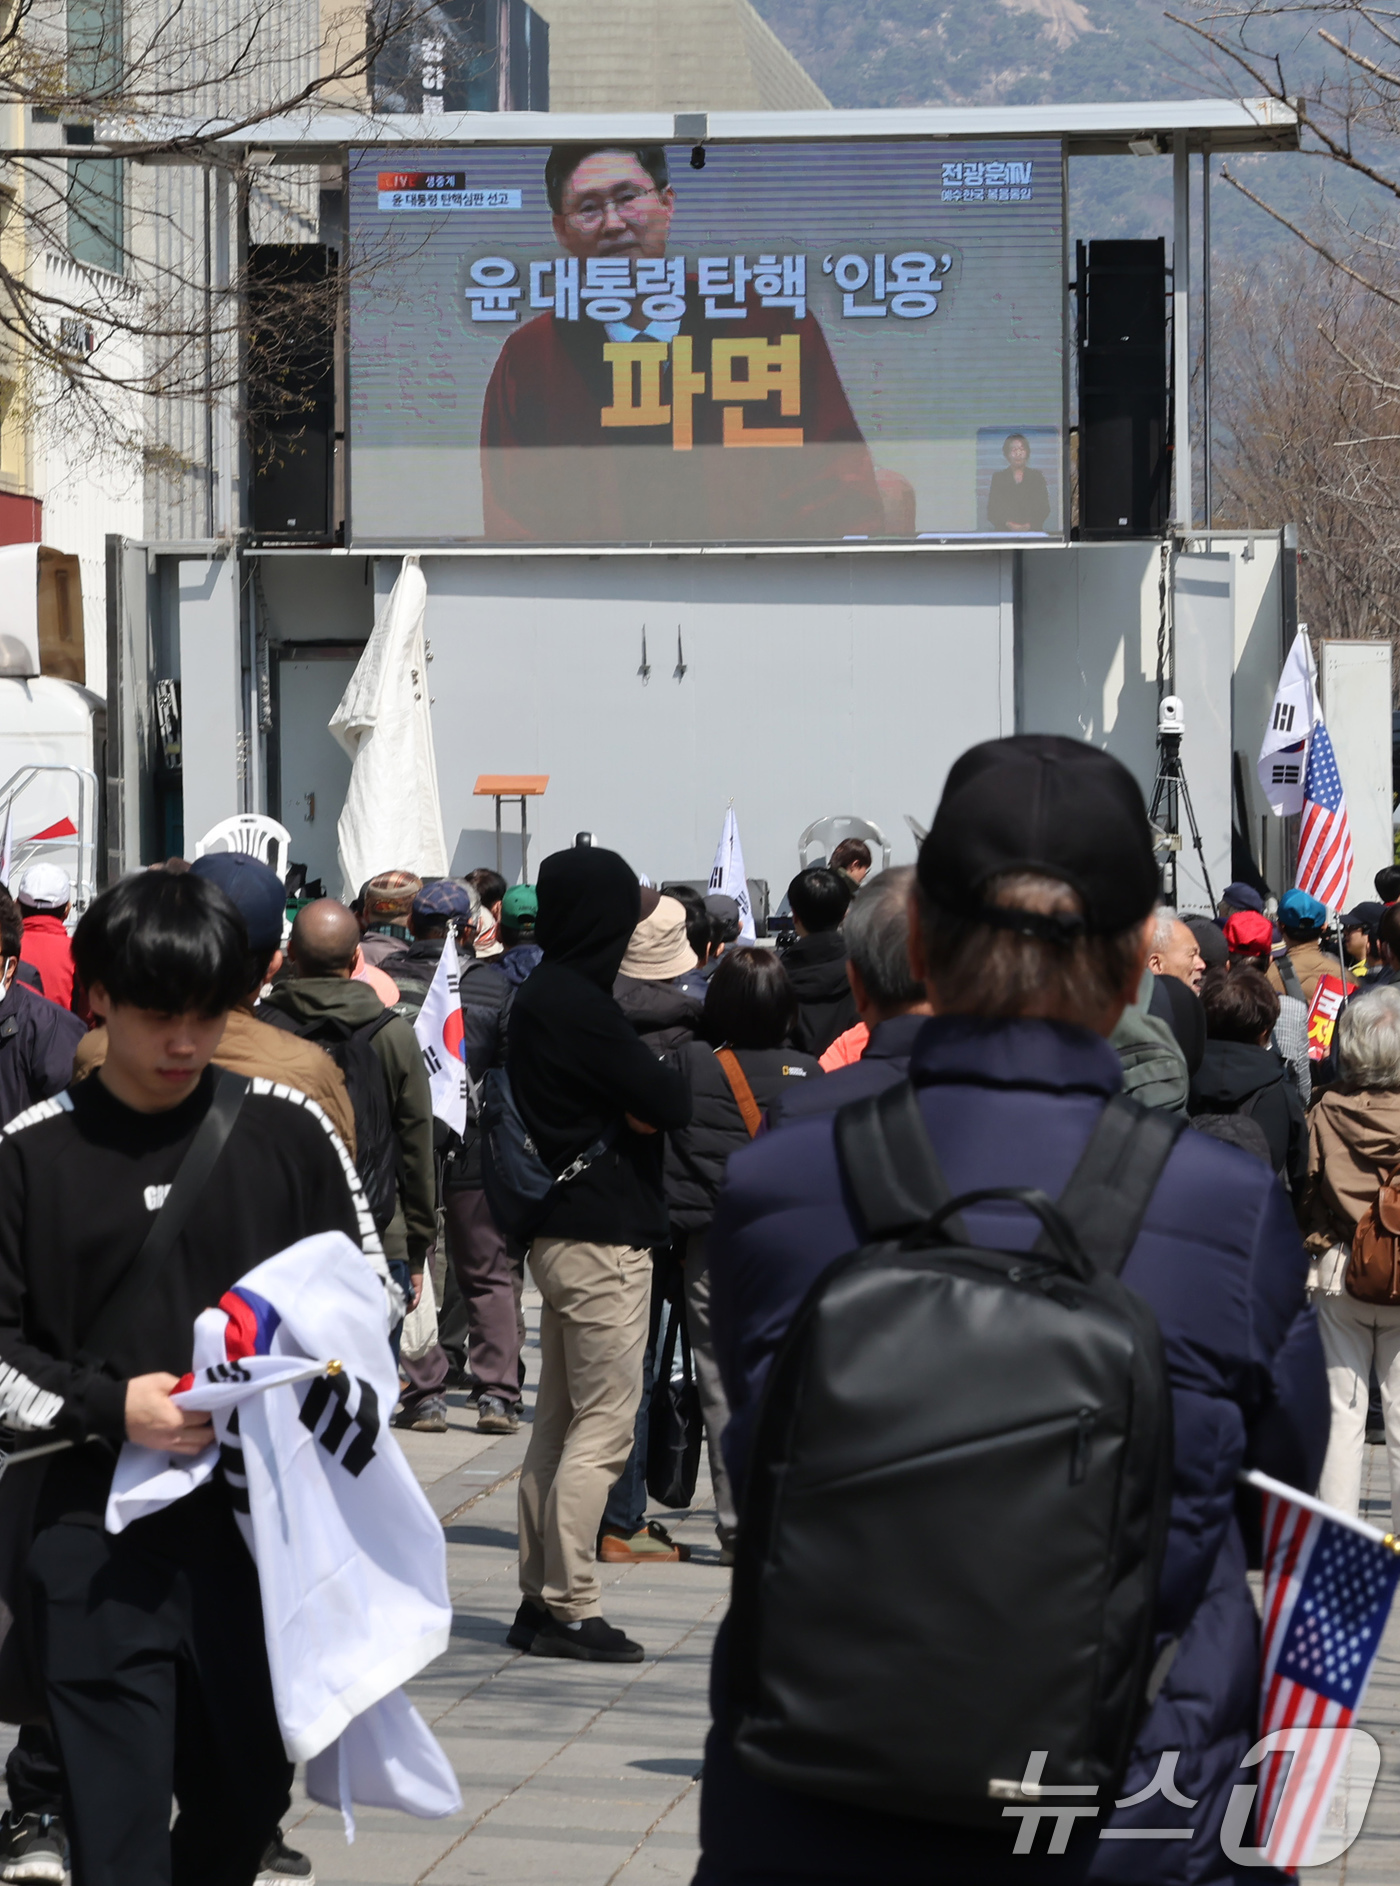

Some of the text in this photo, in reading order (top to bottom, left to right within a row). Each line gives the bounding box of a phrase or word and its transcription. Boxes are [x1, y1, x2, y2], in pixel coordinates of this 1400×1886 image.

[391, 191, 511, 208] 윤 대통령 탄핵심판 선고
[425, 174, 457, 189] 생중계
[465, 255, 523, 323] 윤
[529, 256, 687, 321] 대통령
[698, 254, 808, 320] 탄핵
[601, 334, 804, 451] 파면
